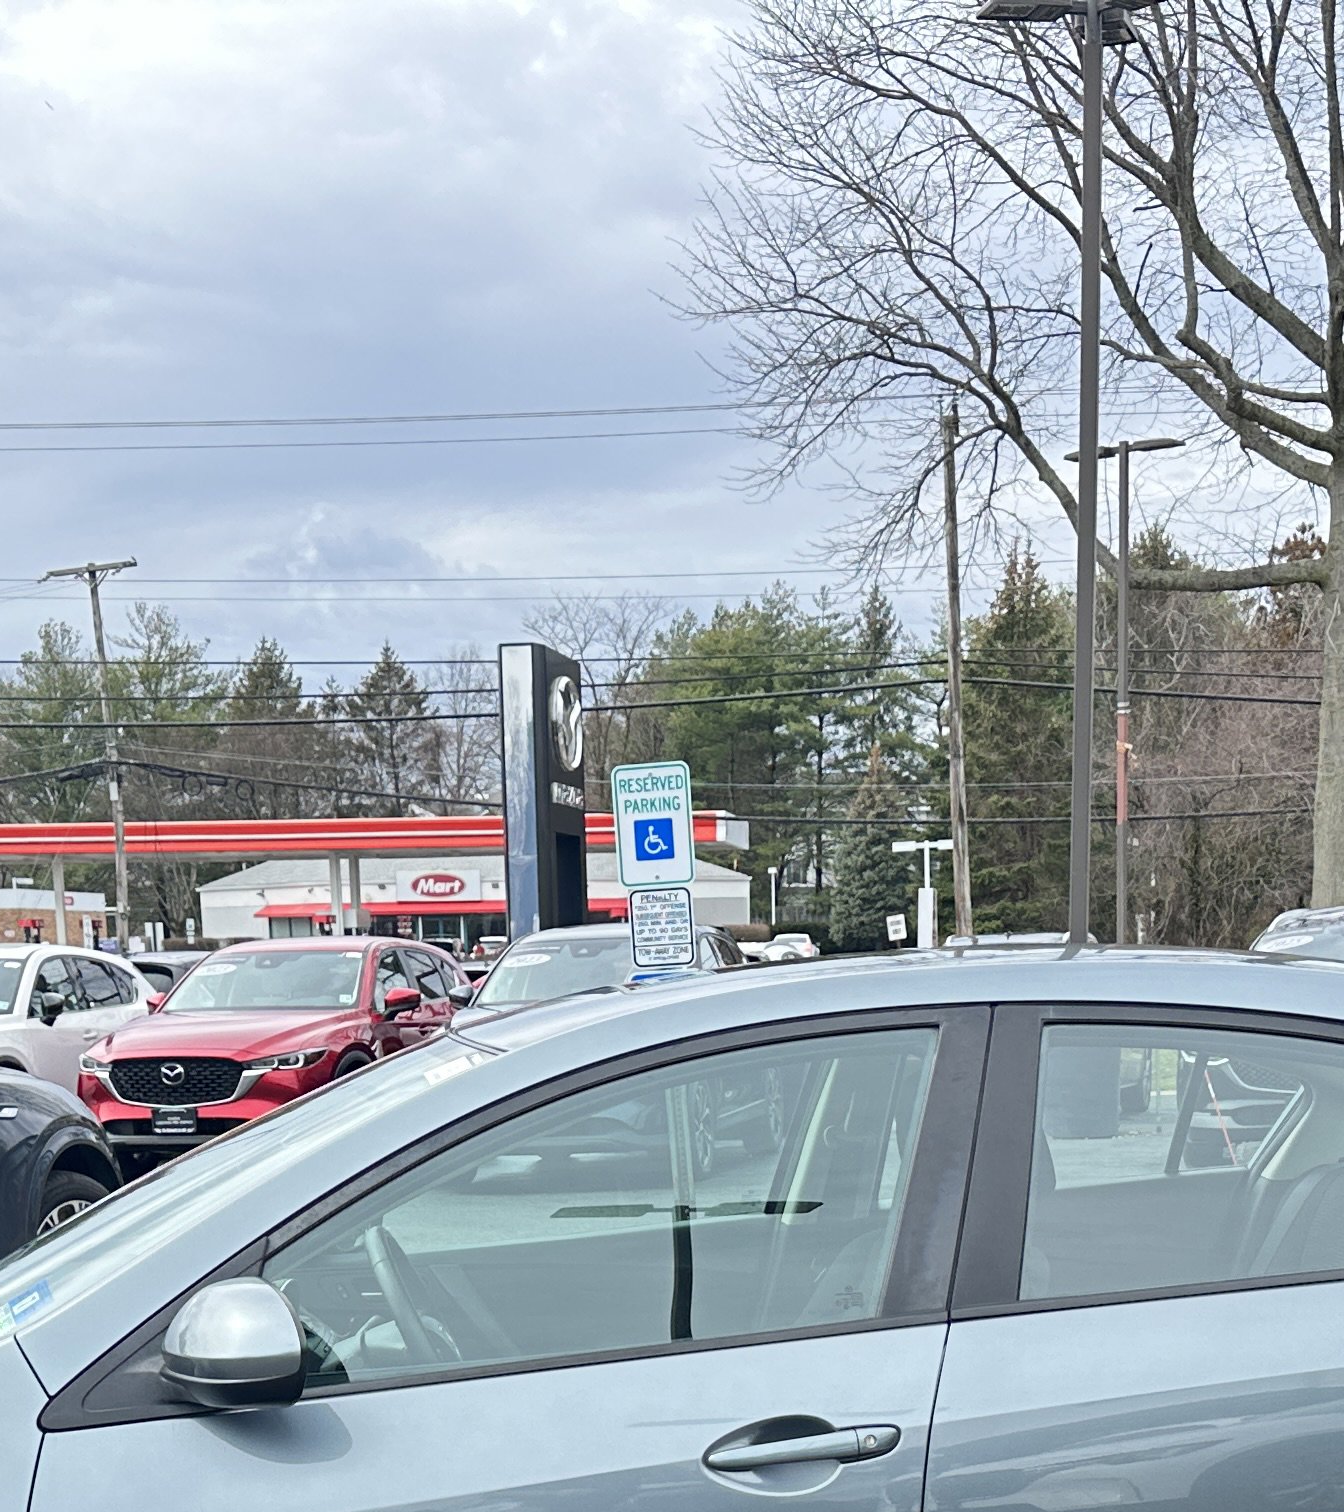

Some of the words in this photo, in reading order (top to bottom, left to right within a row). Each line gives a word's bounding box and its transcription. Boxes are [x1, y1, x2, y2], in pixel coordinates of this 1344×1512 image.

[618, 774, 684, 794] RESERVED
[624, 795, 681, 814] PARKING
[416, 877, 461, 895] Mart
[641, 893, 678, 903] PENALTY
